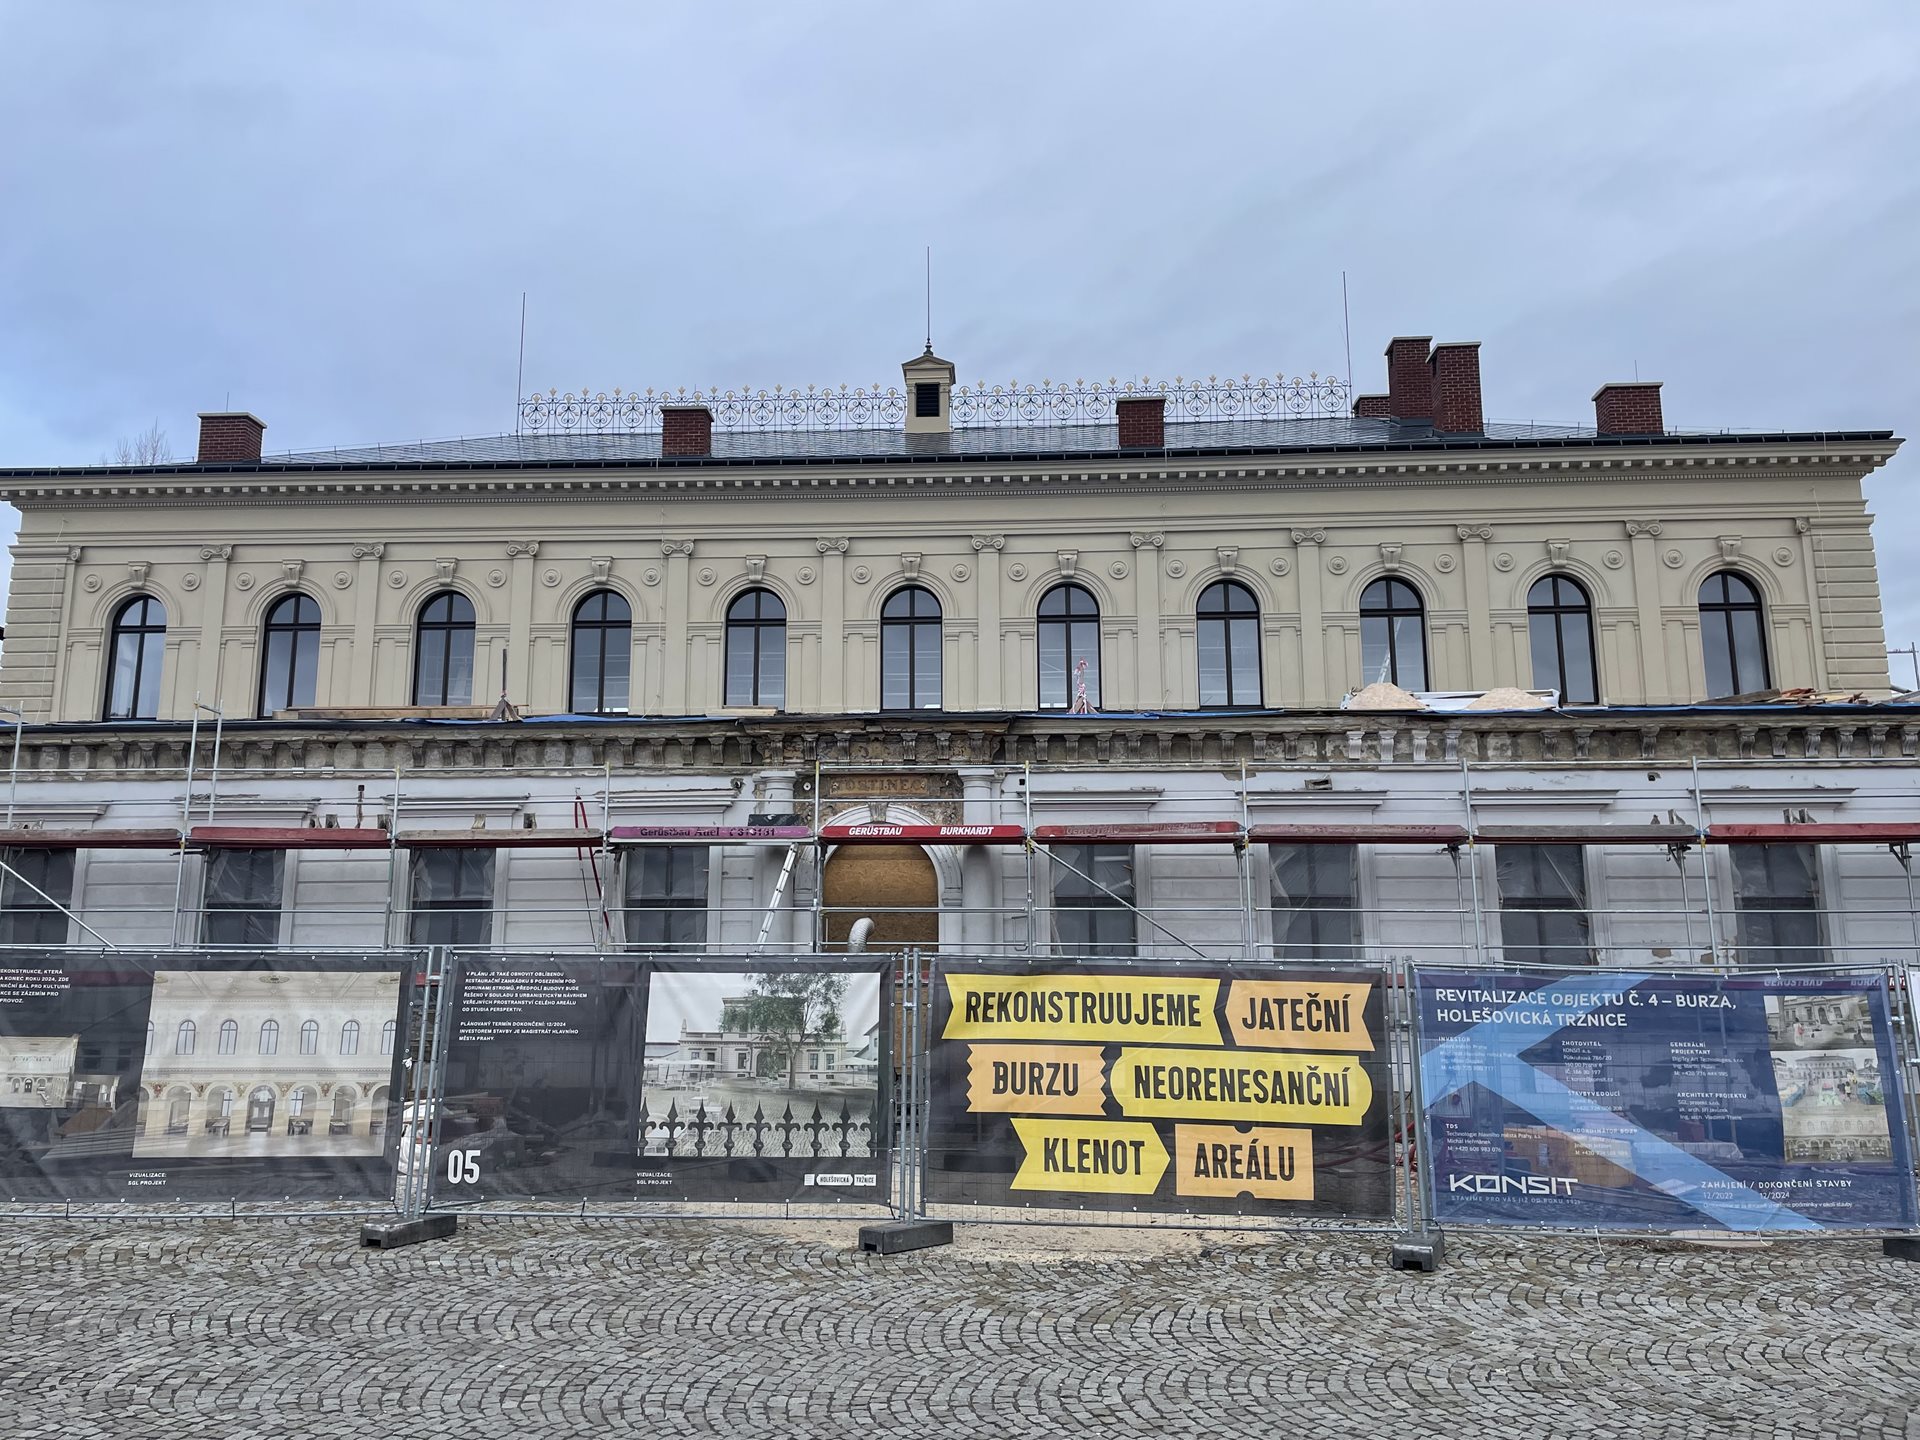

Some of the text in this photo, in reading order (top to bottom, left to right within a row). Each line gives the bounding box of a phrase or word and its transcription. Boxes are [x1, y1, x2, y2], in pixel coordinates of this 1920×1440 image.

[849, 825, 994, 835] GERÜSTBAU BURKHARDT
[1435, 988, 1547, 1005] REVITALIZACE
[1551, 993, 1624, 1007] OBJEKTU
[1628, 990, 1644, 1007] Č.
[1648, 994, 1659, 1006] 4
[1676, 994, 1737, 1010] BURZA,
[965, 991, 1350, 1033] REKONSTRUUJEME JATEČNÍ
[1437, 1007, 1628, 1027] HOLEŠOVICKÁ TRŽNICE
[992, 1060, 1350, 1107] BURZU NEORENESANČNÍ
[447, 1149, 481, 1184] 05
[1043, 1137, 1295, 1181] KLENOT AREÁLU
[1449, 1174, 1579, 1195] KONSIT
[1701, 1179, 1852, 1189] ZAHÁJENÍ / DOKONČENÍ STAVBY
[1703, 1191, 1790, 1200] 12/2022 12/2024
